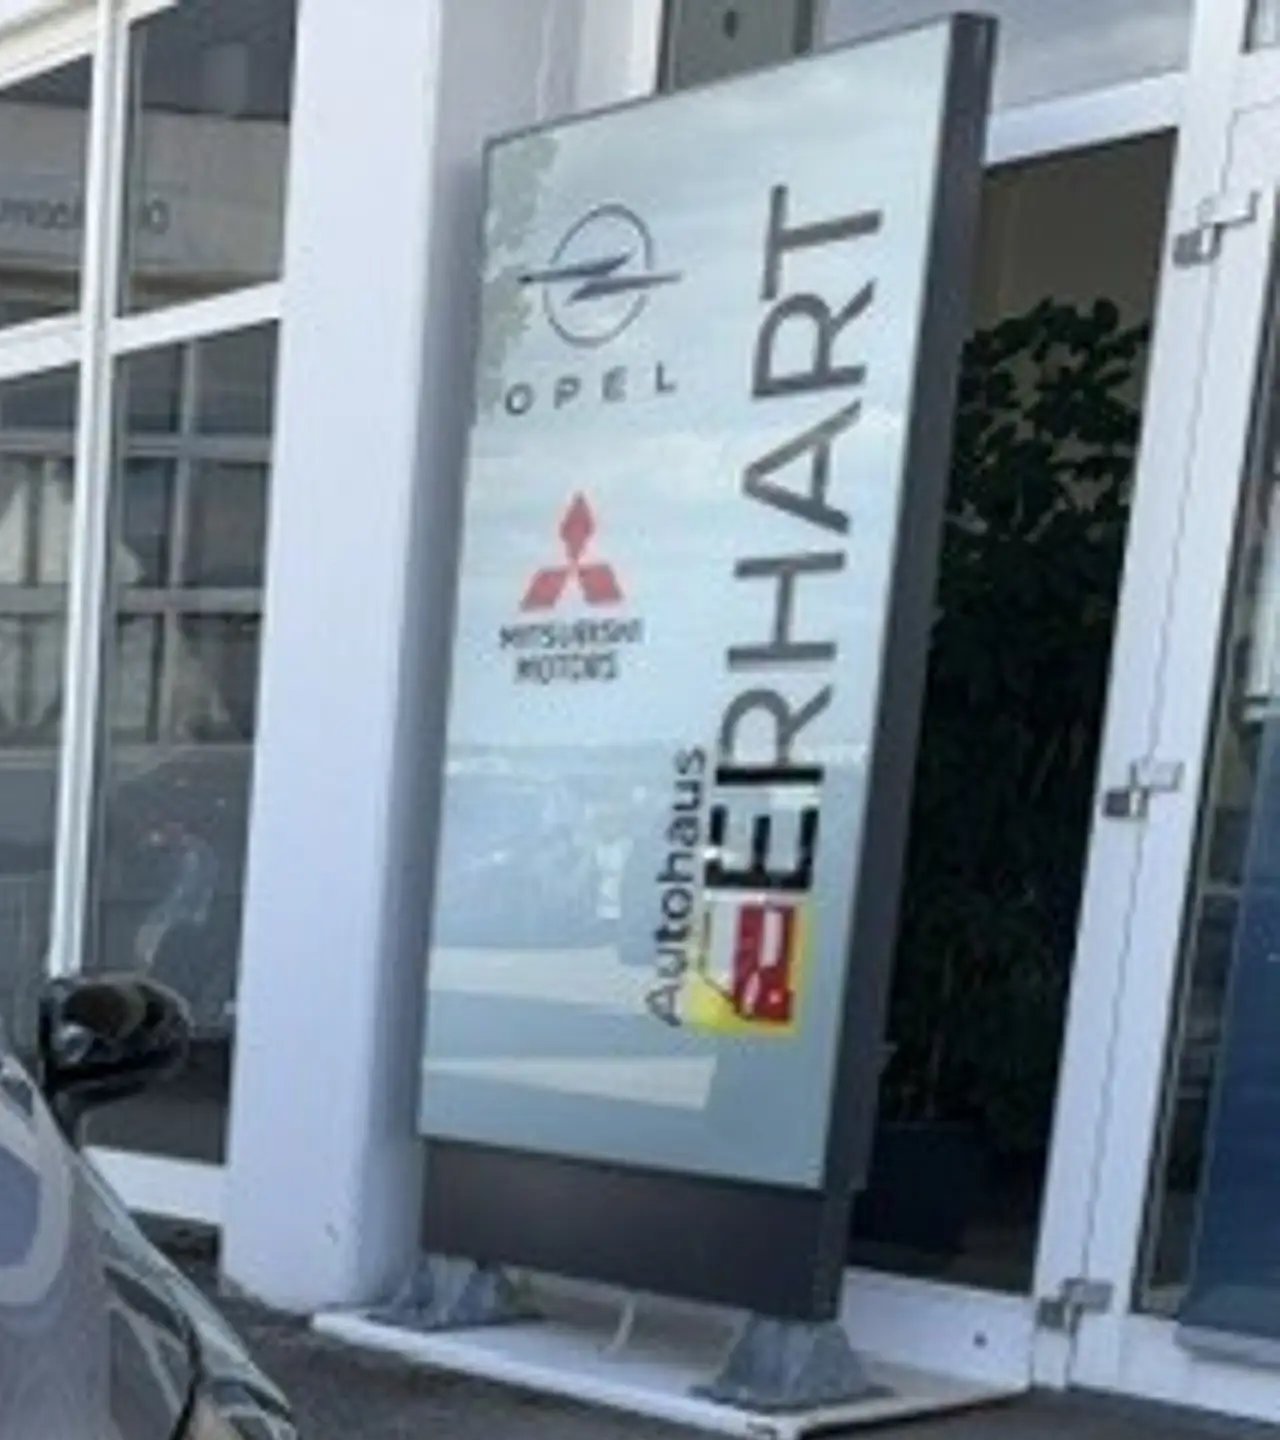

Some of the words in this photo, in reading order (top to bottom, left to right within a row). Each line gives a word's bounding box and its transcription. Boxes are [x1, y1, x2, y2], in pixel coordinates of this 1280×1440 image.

[504, 361, 679, 417] OPEL
[703, 183, 885, 890] ERHART
[644, 746, 709, 1028] Autohaus
